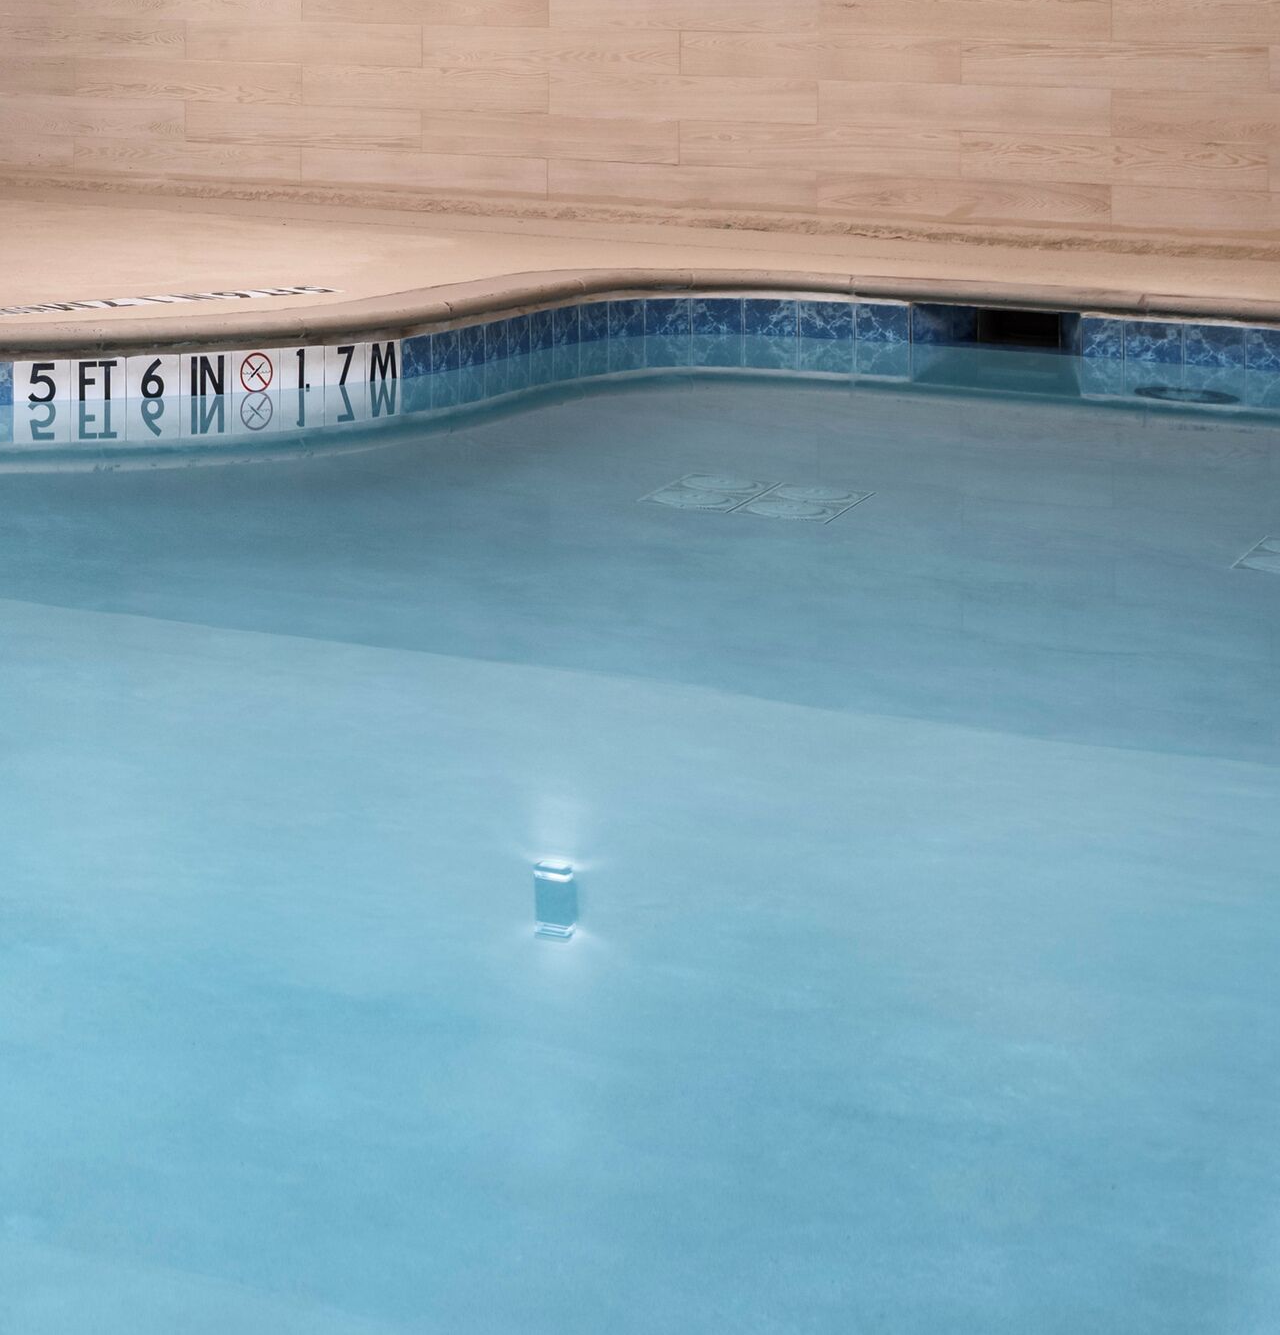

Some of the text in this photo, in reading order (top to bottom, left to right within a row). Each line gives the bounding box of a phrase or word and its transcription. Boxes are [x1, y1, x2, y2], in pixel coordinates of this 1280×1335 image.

[28, 363, 56, 403] 5
[78, 360, 117, 401] FT
[141, 358, 165, 398] 6
[190, 355, 225, 396] IN
[370, 342, 397, 381] M
